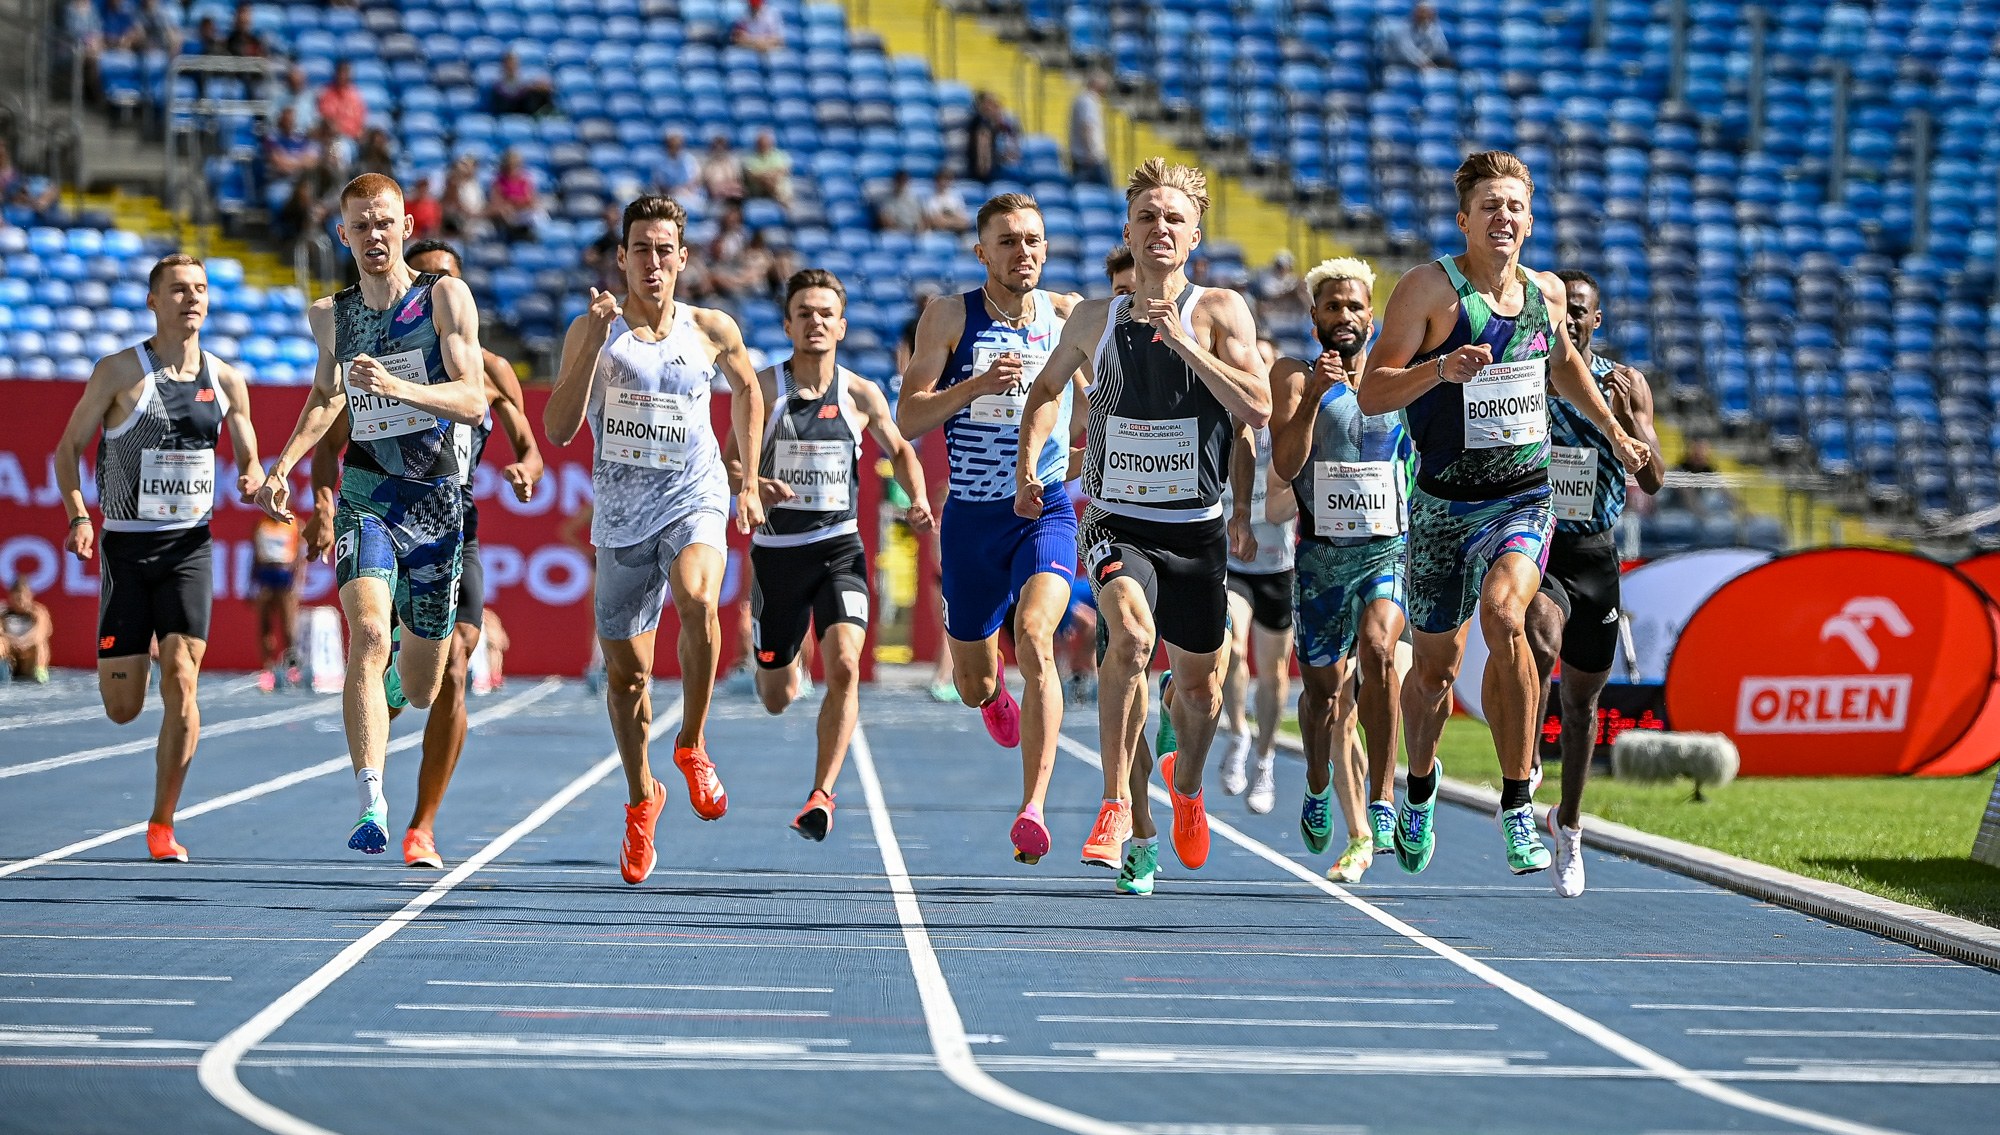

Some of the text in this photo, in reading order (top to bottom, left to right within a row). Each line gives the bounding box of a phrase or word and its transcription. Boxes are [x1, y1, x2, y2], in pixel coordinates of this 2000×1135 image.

[407, 371, 420, 380] 128
[1490, 366, 1511, 375] ORLEN
[1477, 376, 1499, 384] JANUSZA
[630, 394, 652, 402] ORLEN
[1468, 393, 1544, 420] BORKOWSKI
[606, 418, 686, 444] BARONTINI
[1139, 430, 1184, 438] KUSOCIŃSKIEGO
[1177, 440, 1191, 448] 123
[1109, 451, 1194, 473] OSTROWSKI
[778, 468, 848, 486] AUGUSTYNIAK
[143, 479, 212, 496] LEWALSKI
[1327, 493, 1386, 510] SMAILI
[336, 536, 348, 561] 6
[1751, 687, 1897, 722] ORLEN
